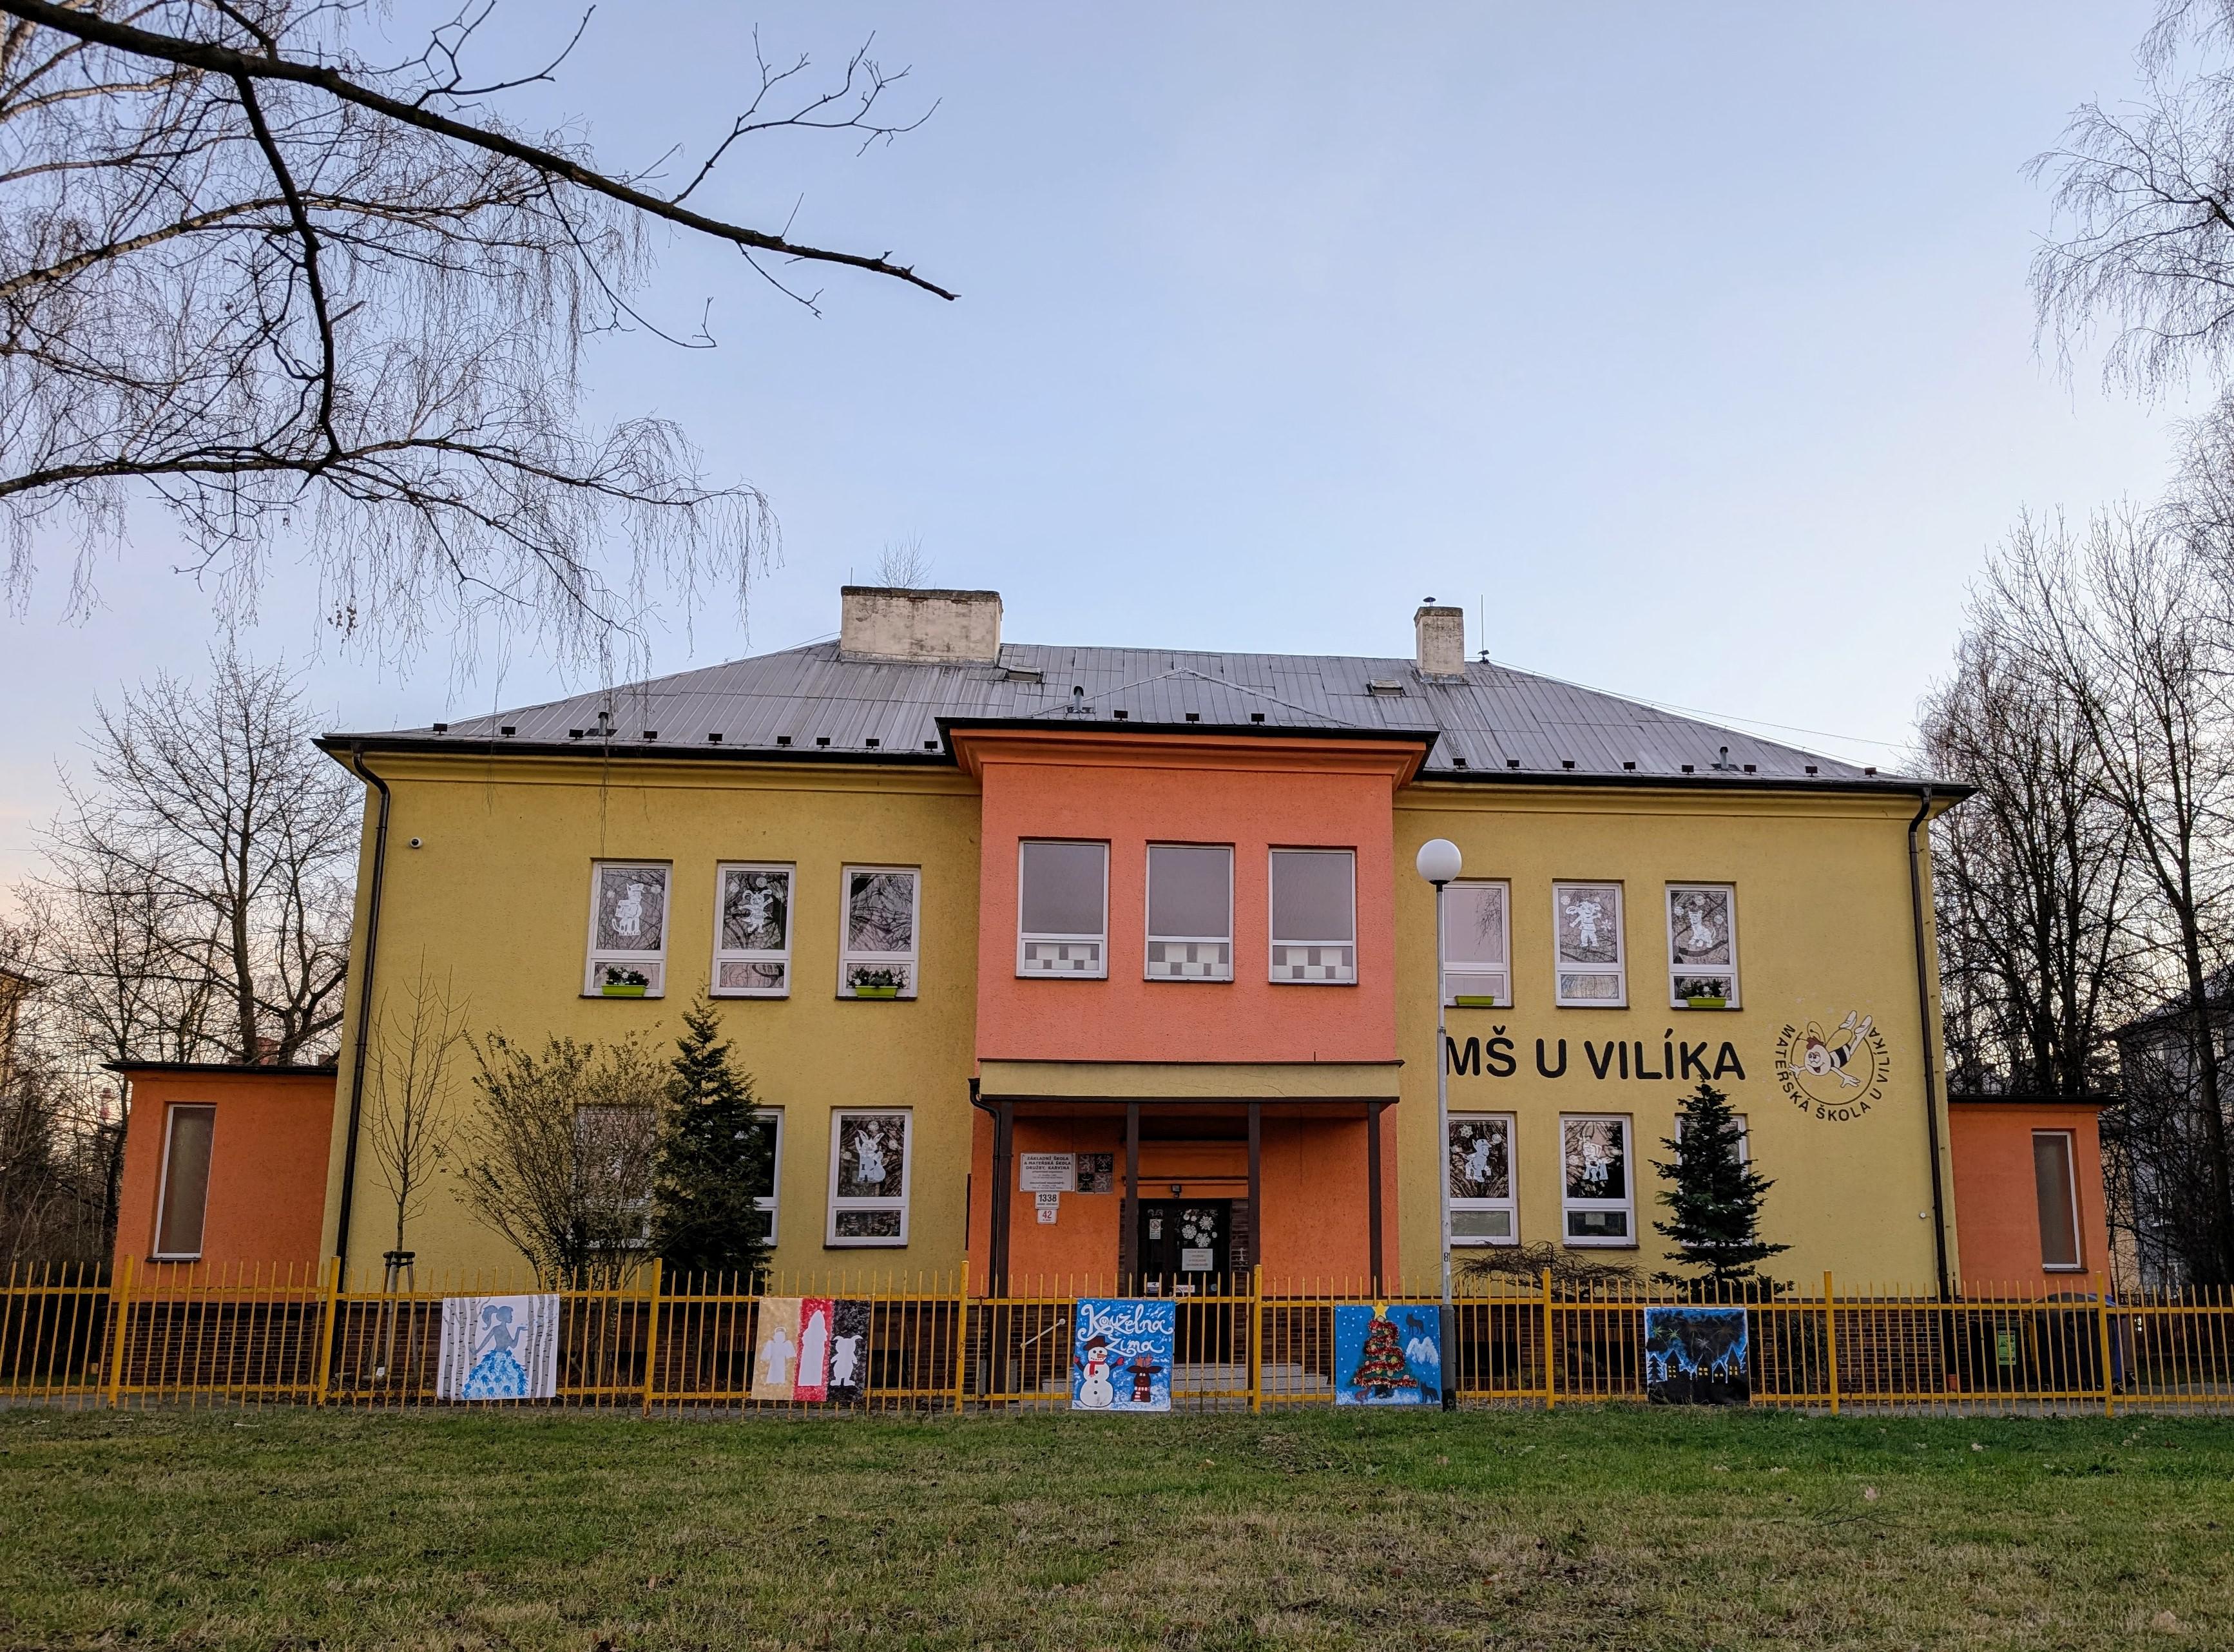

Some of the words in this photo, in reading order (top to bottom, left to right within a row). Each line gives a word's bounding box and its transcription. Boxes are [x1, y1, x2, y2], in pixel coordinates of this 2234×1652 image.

[1446, 1024, 1517, 1077] MŠ
[1536, 1038, 1567, 1079] U
[1583, 1028, 1746, 1081] VILÍKA
[1869, 1026, 1890, 1083] VILÍKA
[1775, 1023, 1811, 1112] MATEŘSKÁ
[1869, 1088, 1882, 1100] U
[1815, 1101, 1871, 1122] ŠKOLA
[1038, 1194, 1057, 1202] 1338
[1042, 1211, 1052, 1219] 42
